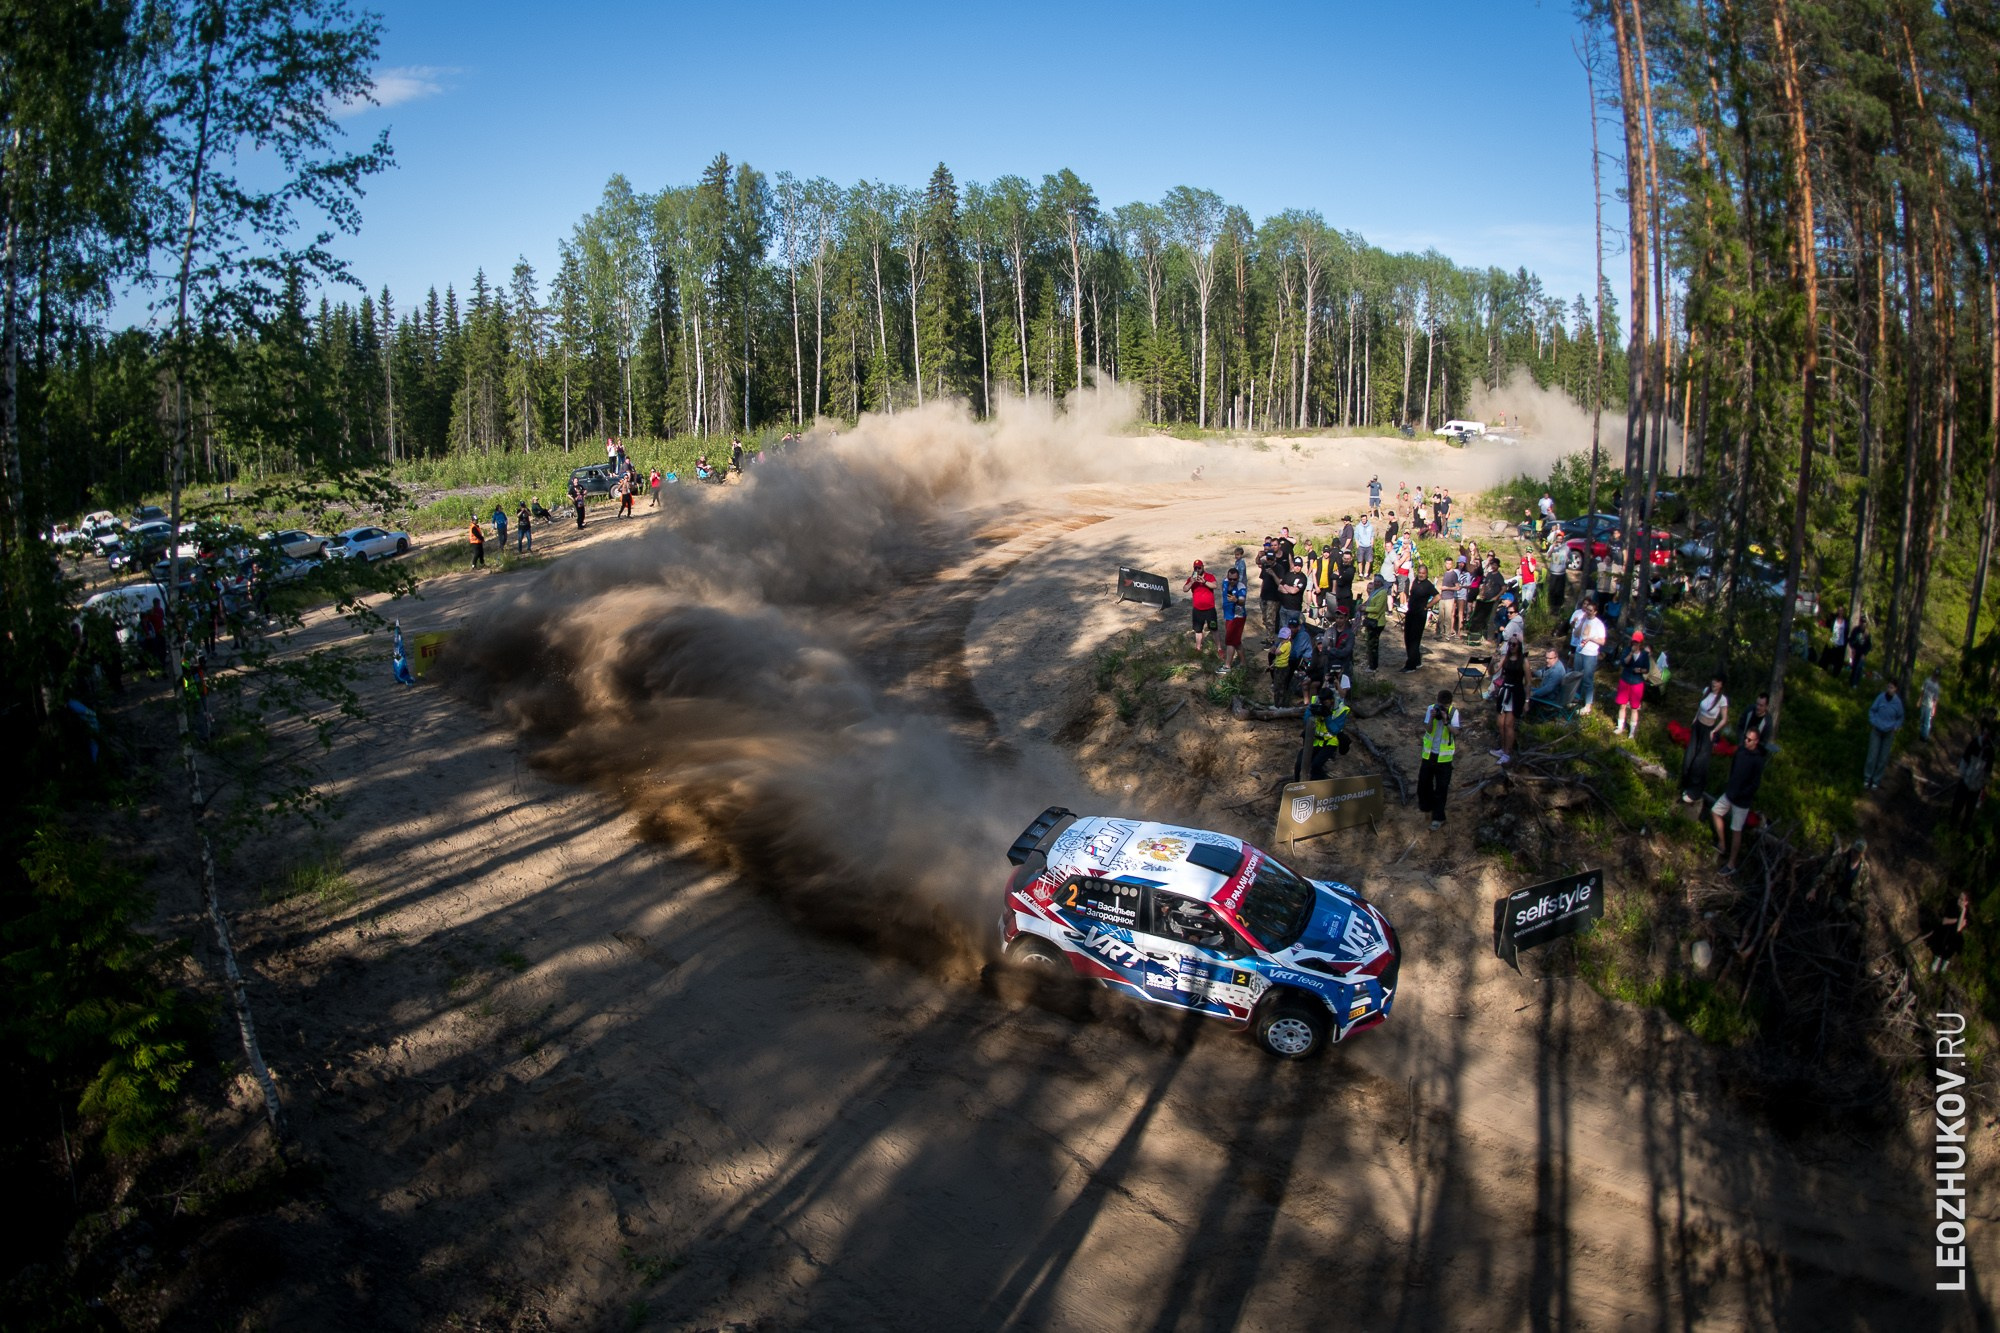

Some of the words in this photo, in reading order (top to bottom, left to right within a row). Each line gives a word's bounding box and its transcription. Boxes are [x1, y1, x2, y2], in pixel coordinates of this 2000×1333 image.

[1132, 580, 1164, 592] YOKOHAMA
[1316, 788, 1375, 807] КОРПОРАЦИЯ
[1316, 804, 1339, 814] РУСЬ
[1066, 884, 1079, 907] 2
[1231, 875, 1250, 901] РАЛЛИ
[1086, 907, 1135, 926] Загороднюк
[1097, 902, 1136, 918] Васильев
[1338, 910, 1372, 957] VRT
[1084, 925, 1150, 968] VRT
[1236, 974, 1246, 984] 2
[1269, 969, 1299, 980] VRT
